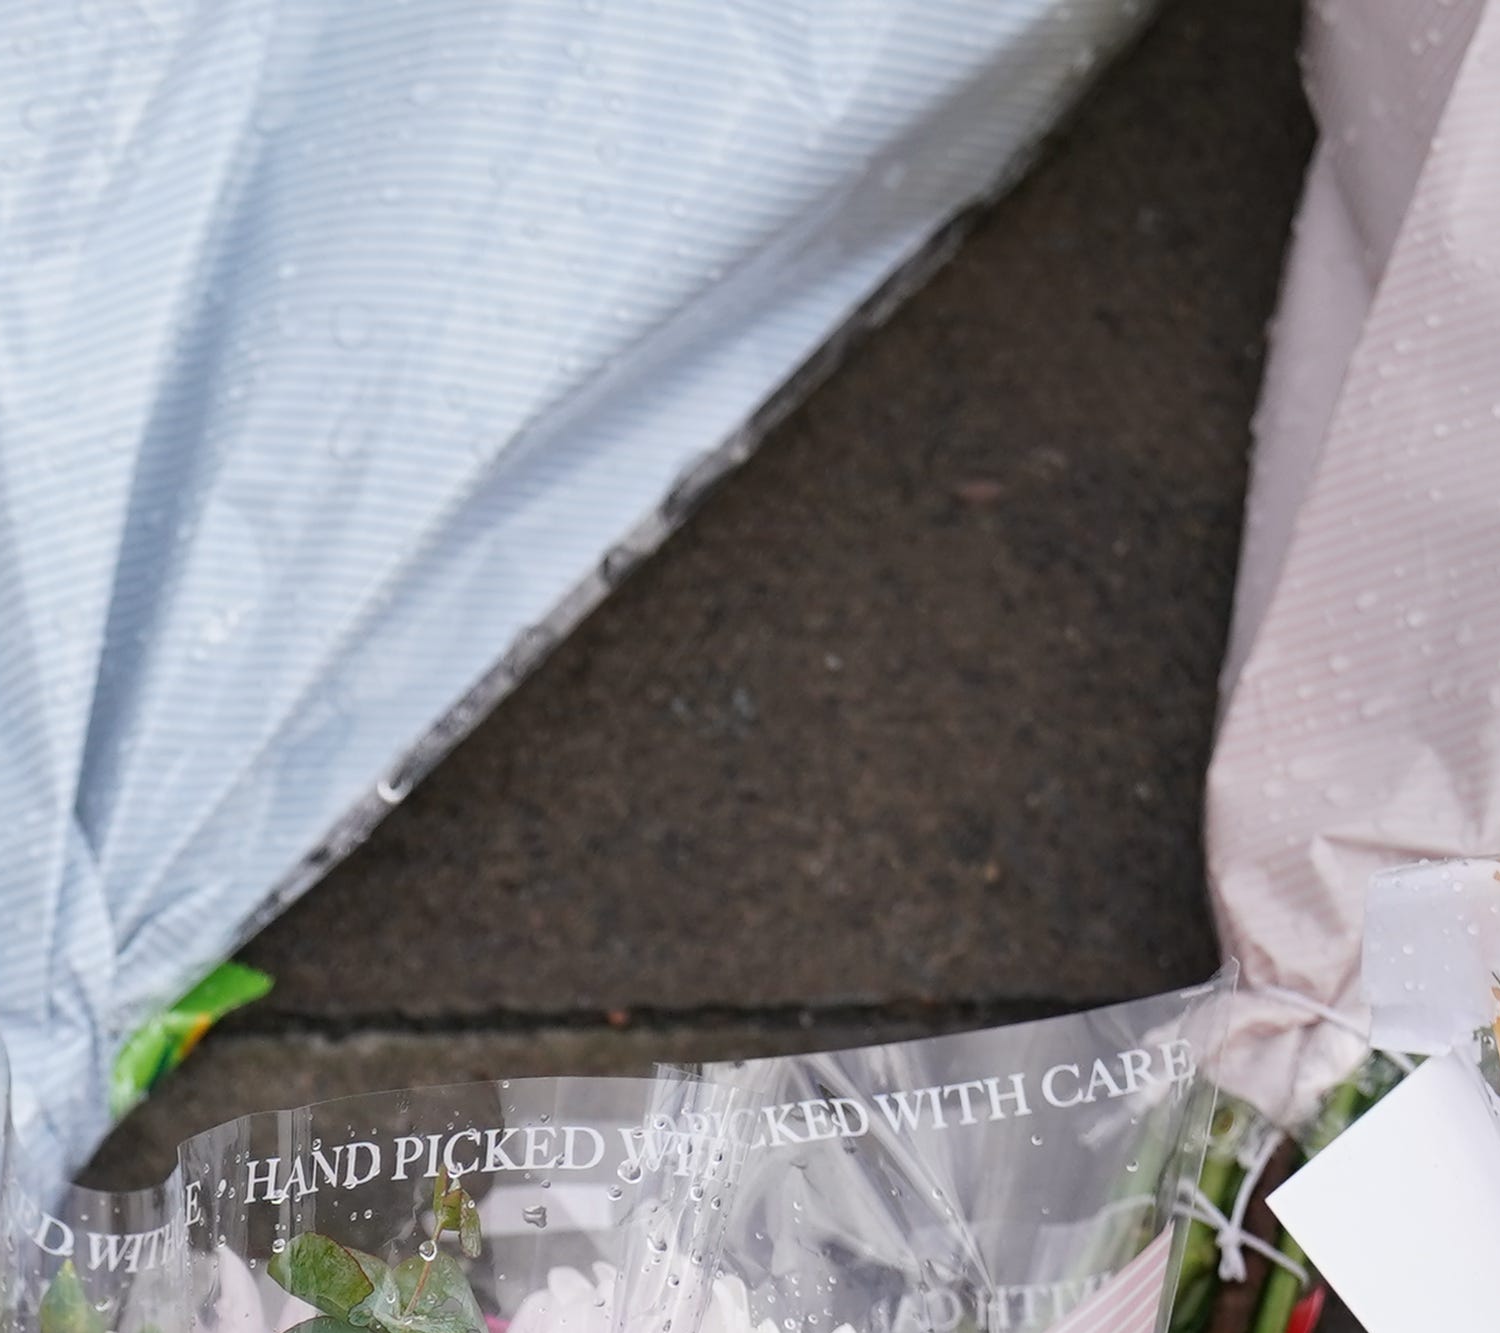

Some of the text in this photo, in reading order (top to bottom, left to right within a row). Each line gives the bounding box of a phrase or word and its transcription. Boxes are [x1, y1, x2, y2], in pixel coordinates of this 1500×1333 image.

[873, 1071, 1032, 1135] WITH
[1041, 1038, 1198, 1110] CARE
[244, 1139, 381, 1204] HAND
[392, 1125, 604, 1183] PICKED
